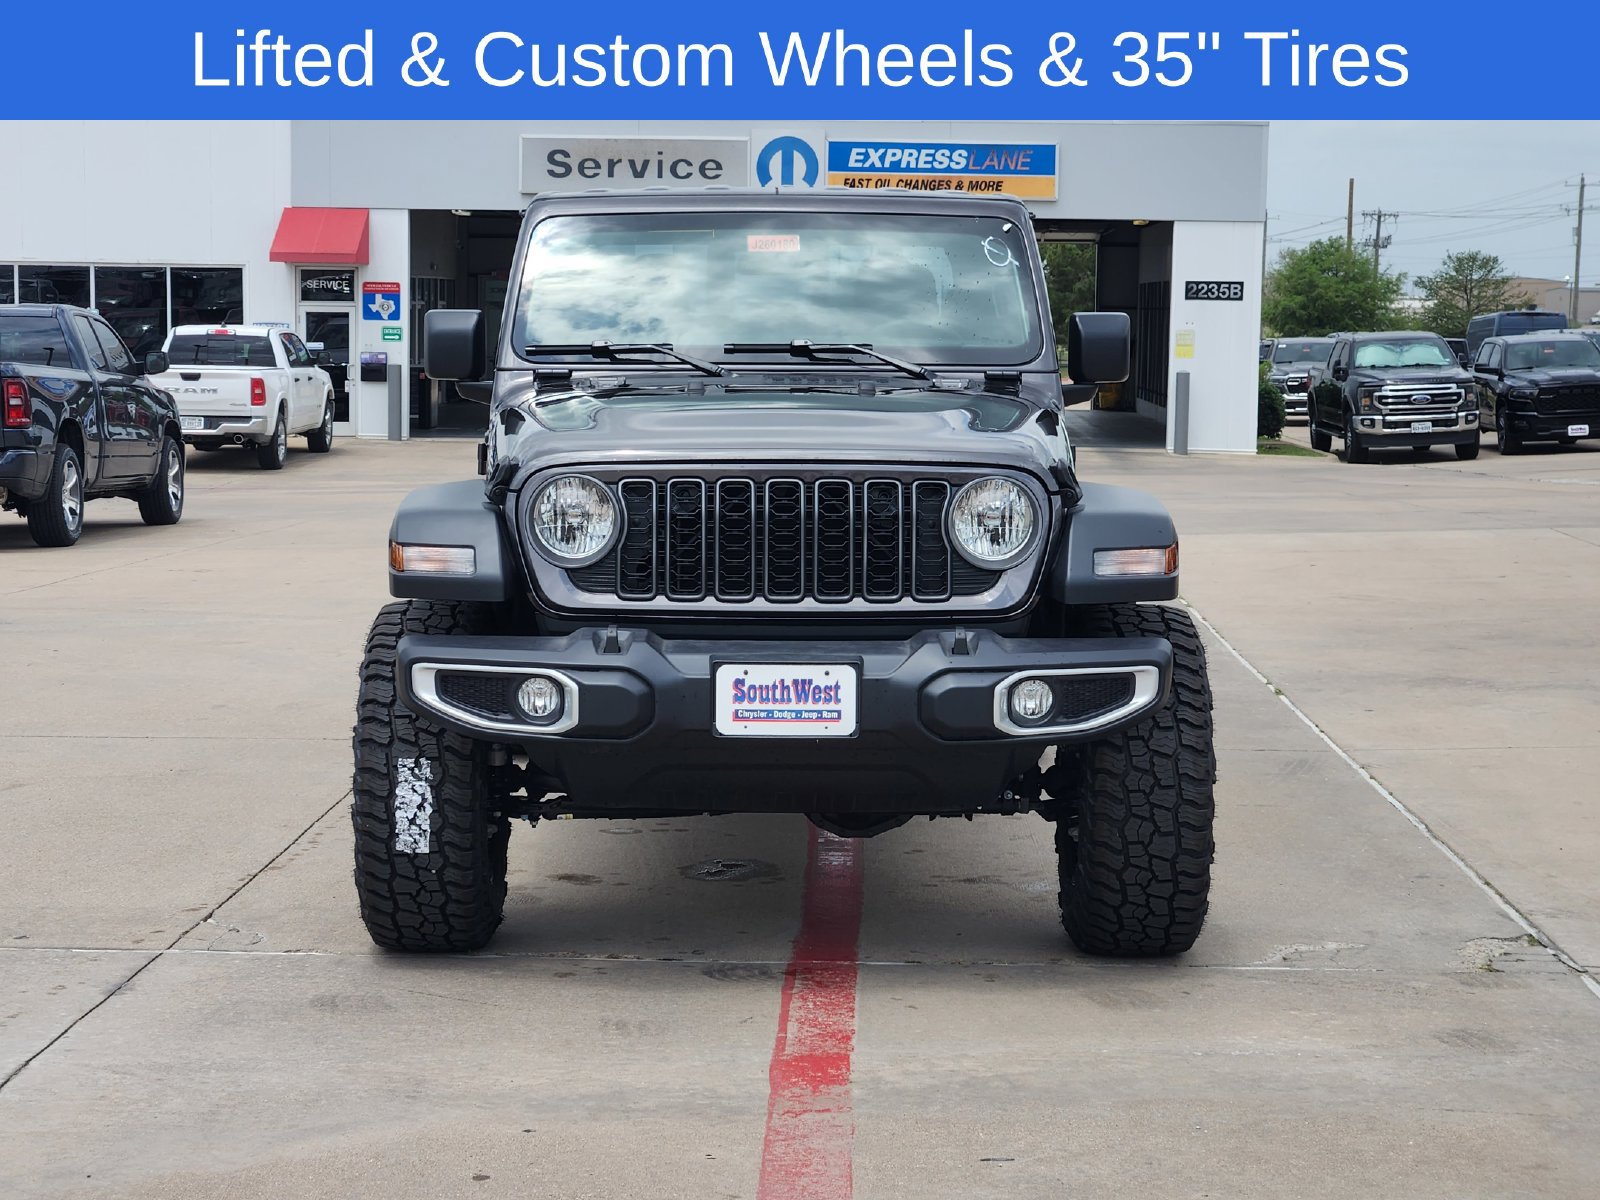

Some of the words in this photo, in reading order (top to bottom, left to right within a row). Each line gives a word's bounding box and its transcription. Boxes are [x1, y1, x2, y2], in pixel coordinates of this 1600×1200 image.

[546, 149, 724, 180] Service
[843, 177, 872, 188] FAST
[895, 178, 952, 192] CHANGES
[954, 180, 965, 192] &
[966, 179, 1004, 192] MORE
[306, 279, 350, 290] SERVICE
[1187, 283, 1242, 299] 2235B
[163, 386, 218, 395] RAM
[732, 677, 842, 705] SouthWest
[737, 709, 768, 719] Chrysler
[773, 710, 796, 720] Dodge
[801, 710, 818, 720] Jeep
[822, 710, 839, 719] Ram
